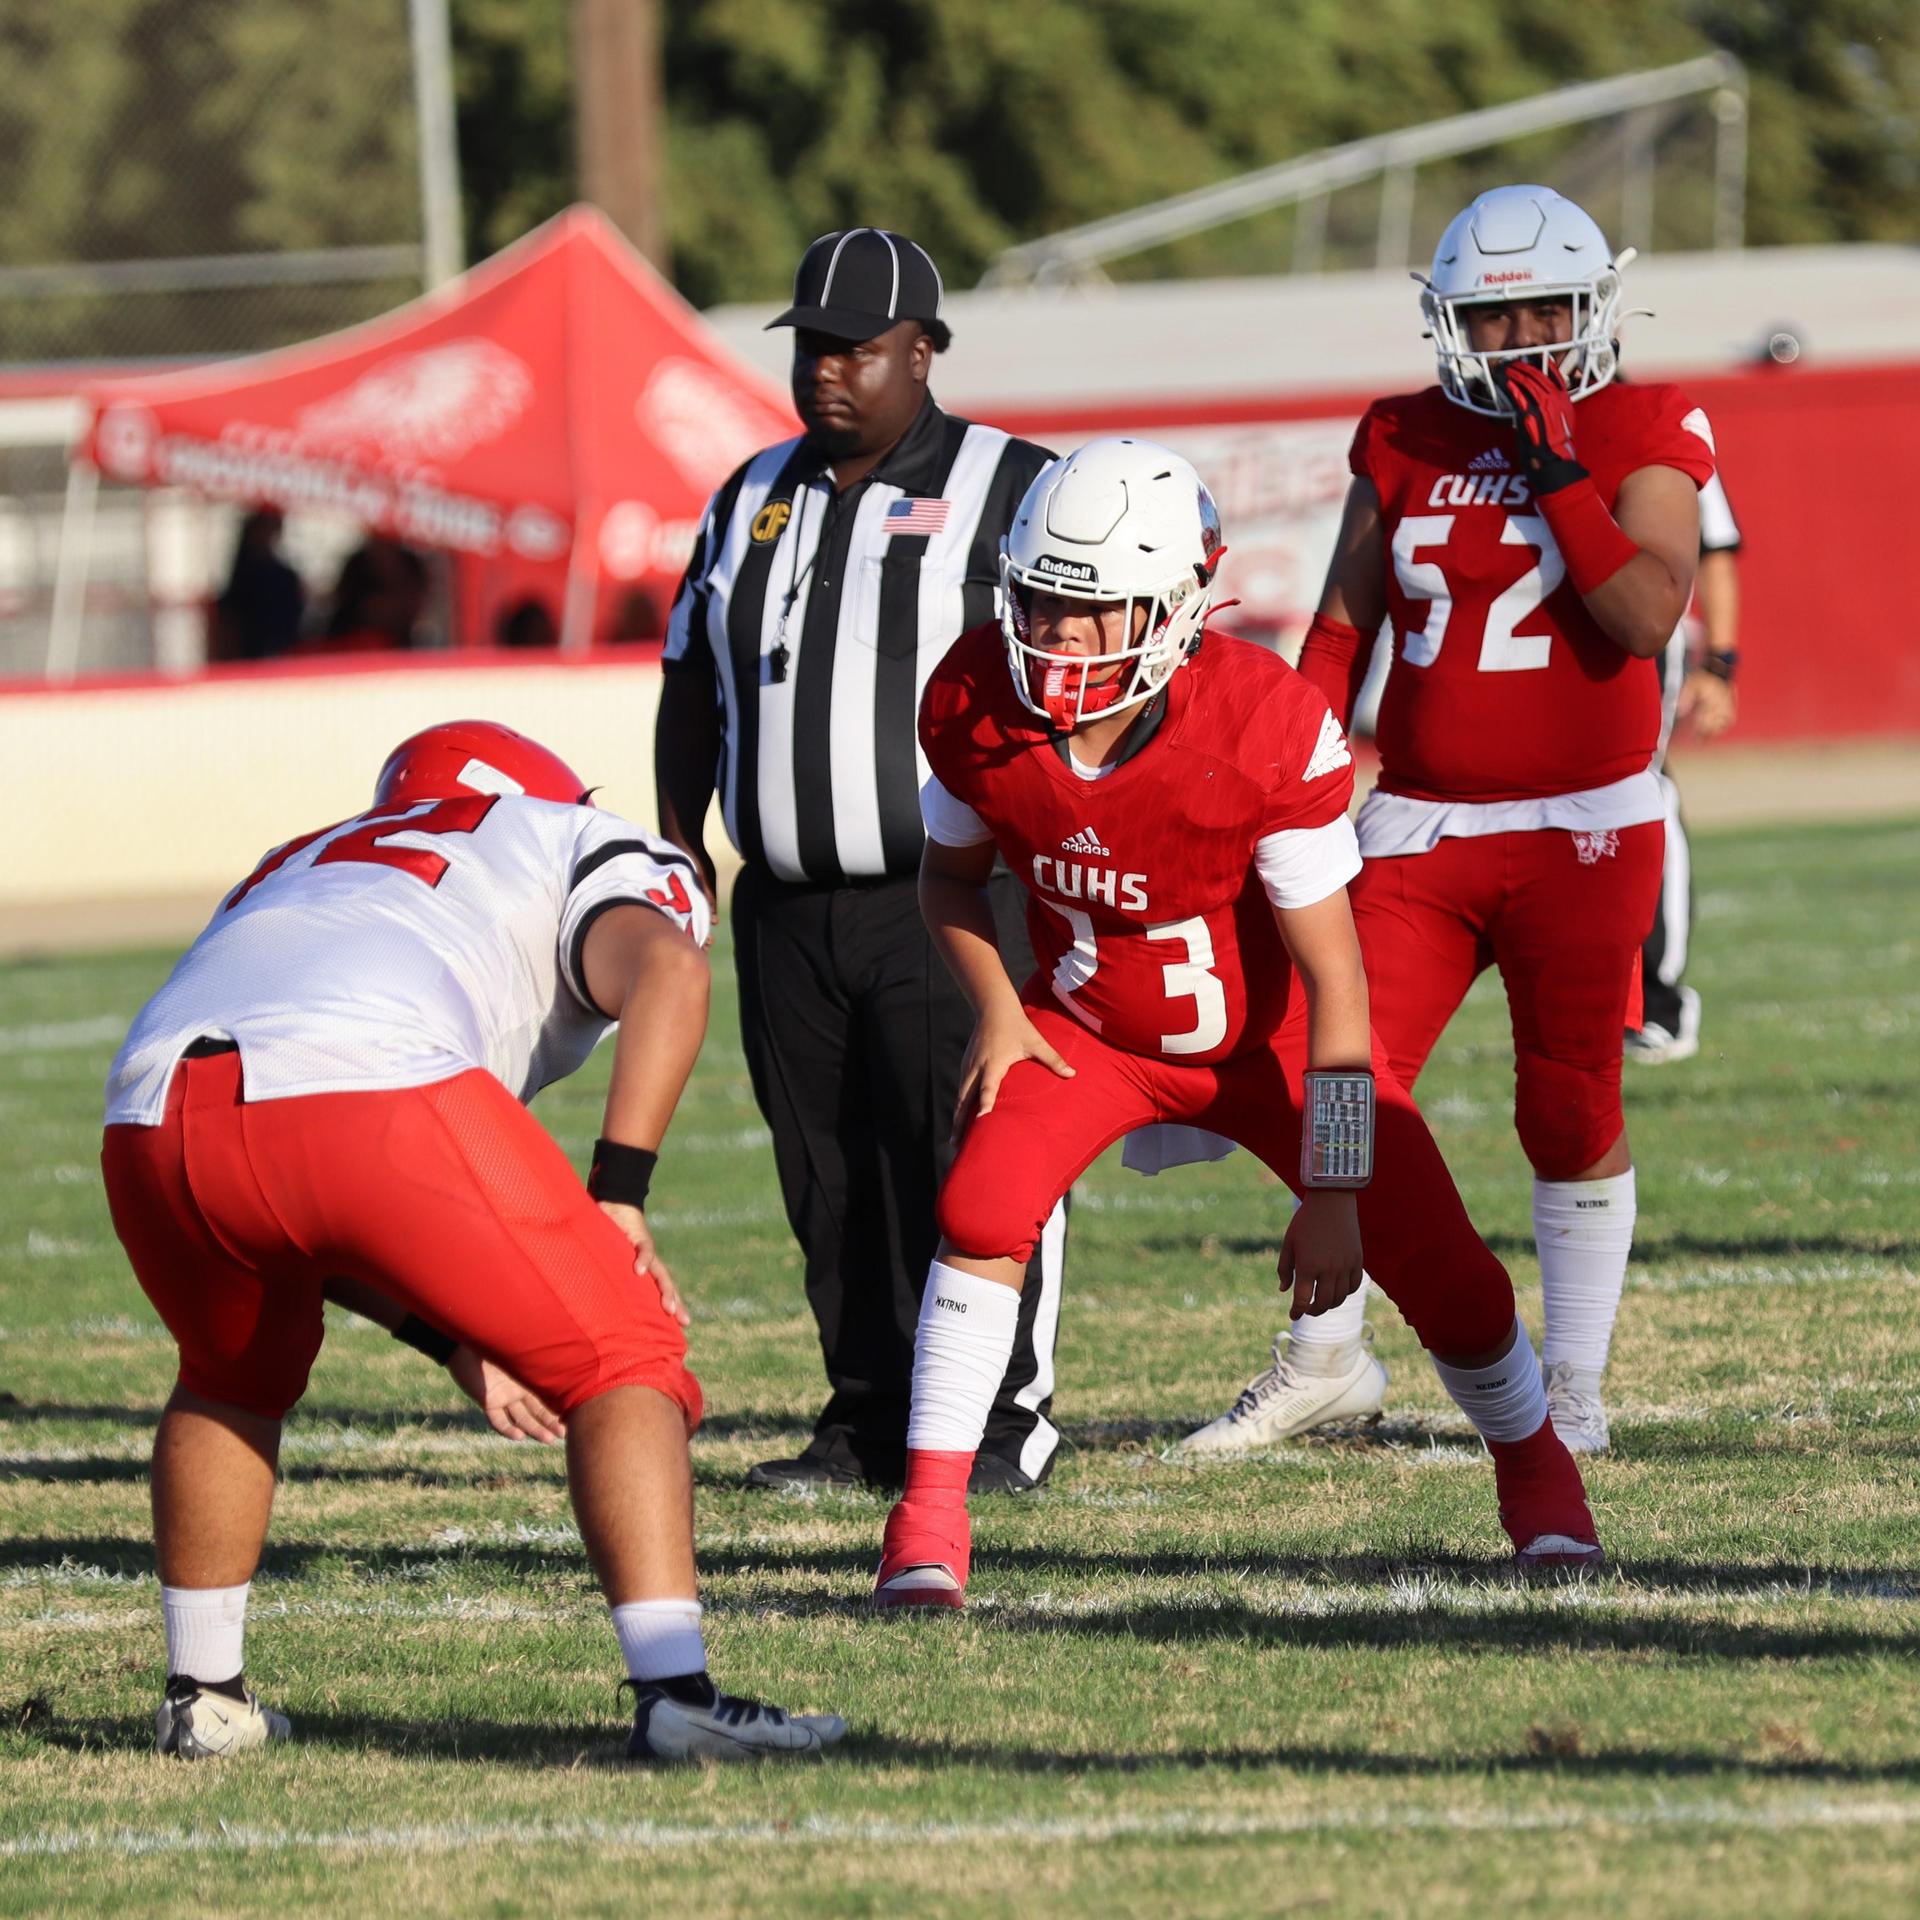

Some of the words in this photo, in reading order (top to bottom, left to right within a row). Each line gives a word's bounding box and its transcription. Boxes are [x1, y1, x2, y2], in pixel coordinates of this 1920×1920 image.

[1428, 474, 1530, 508] CUHS
[1040, 557, 1091, 580] Riddell
[1391, 514, 1566, 672] 52
[1061, 841, 1110, 857] adidas
[1033, 853, 1149, 912] CUHS
[1036, 894, 1229, 1054] 23
